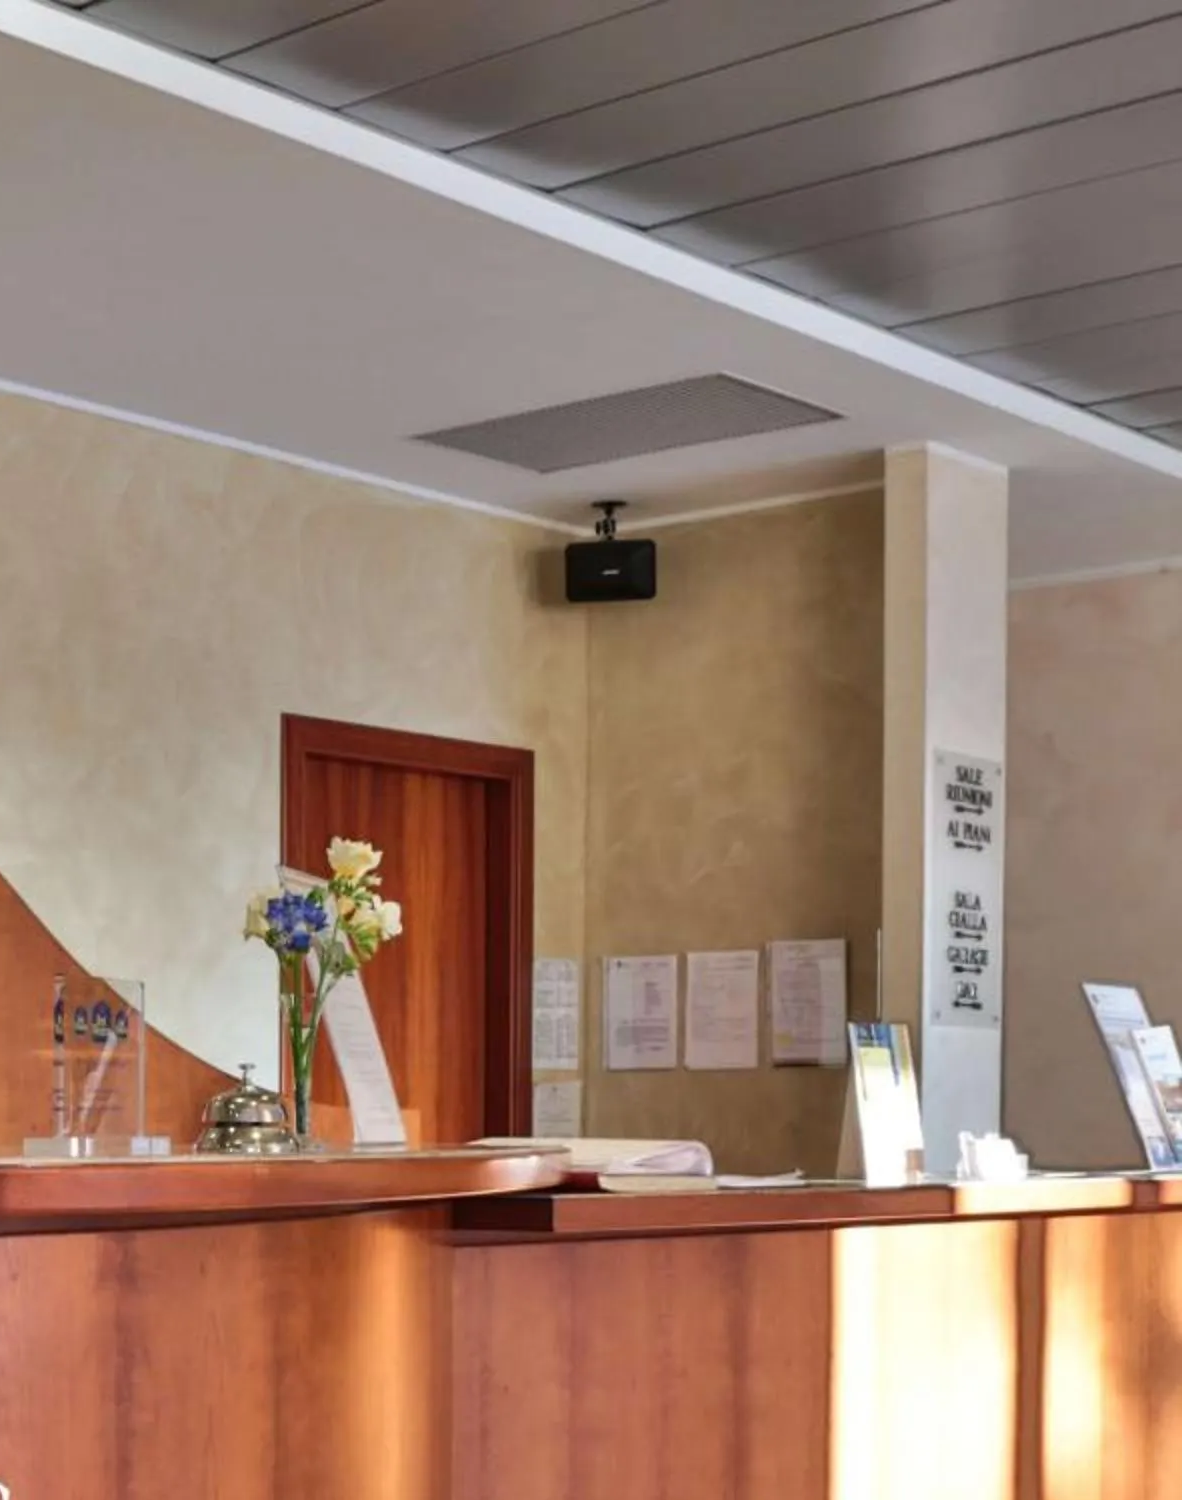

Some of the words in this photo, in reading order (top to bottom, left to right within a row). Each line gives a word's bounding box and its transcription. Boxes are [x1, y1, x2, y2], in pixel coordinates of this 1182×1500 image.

[955, 765, 983, 786] SALE
[963, 821, 992, 844] PIANI
[954, 890, 981, 911] SALA
